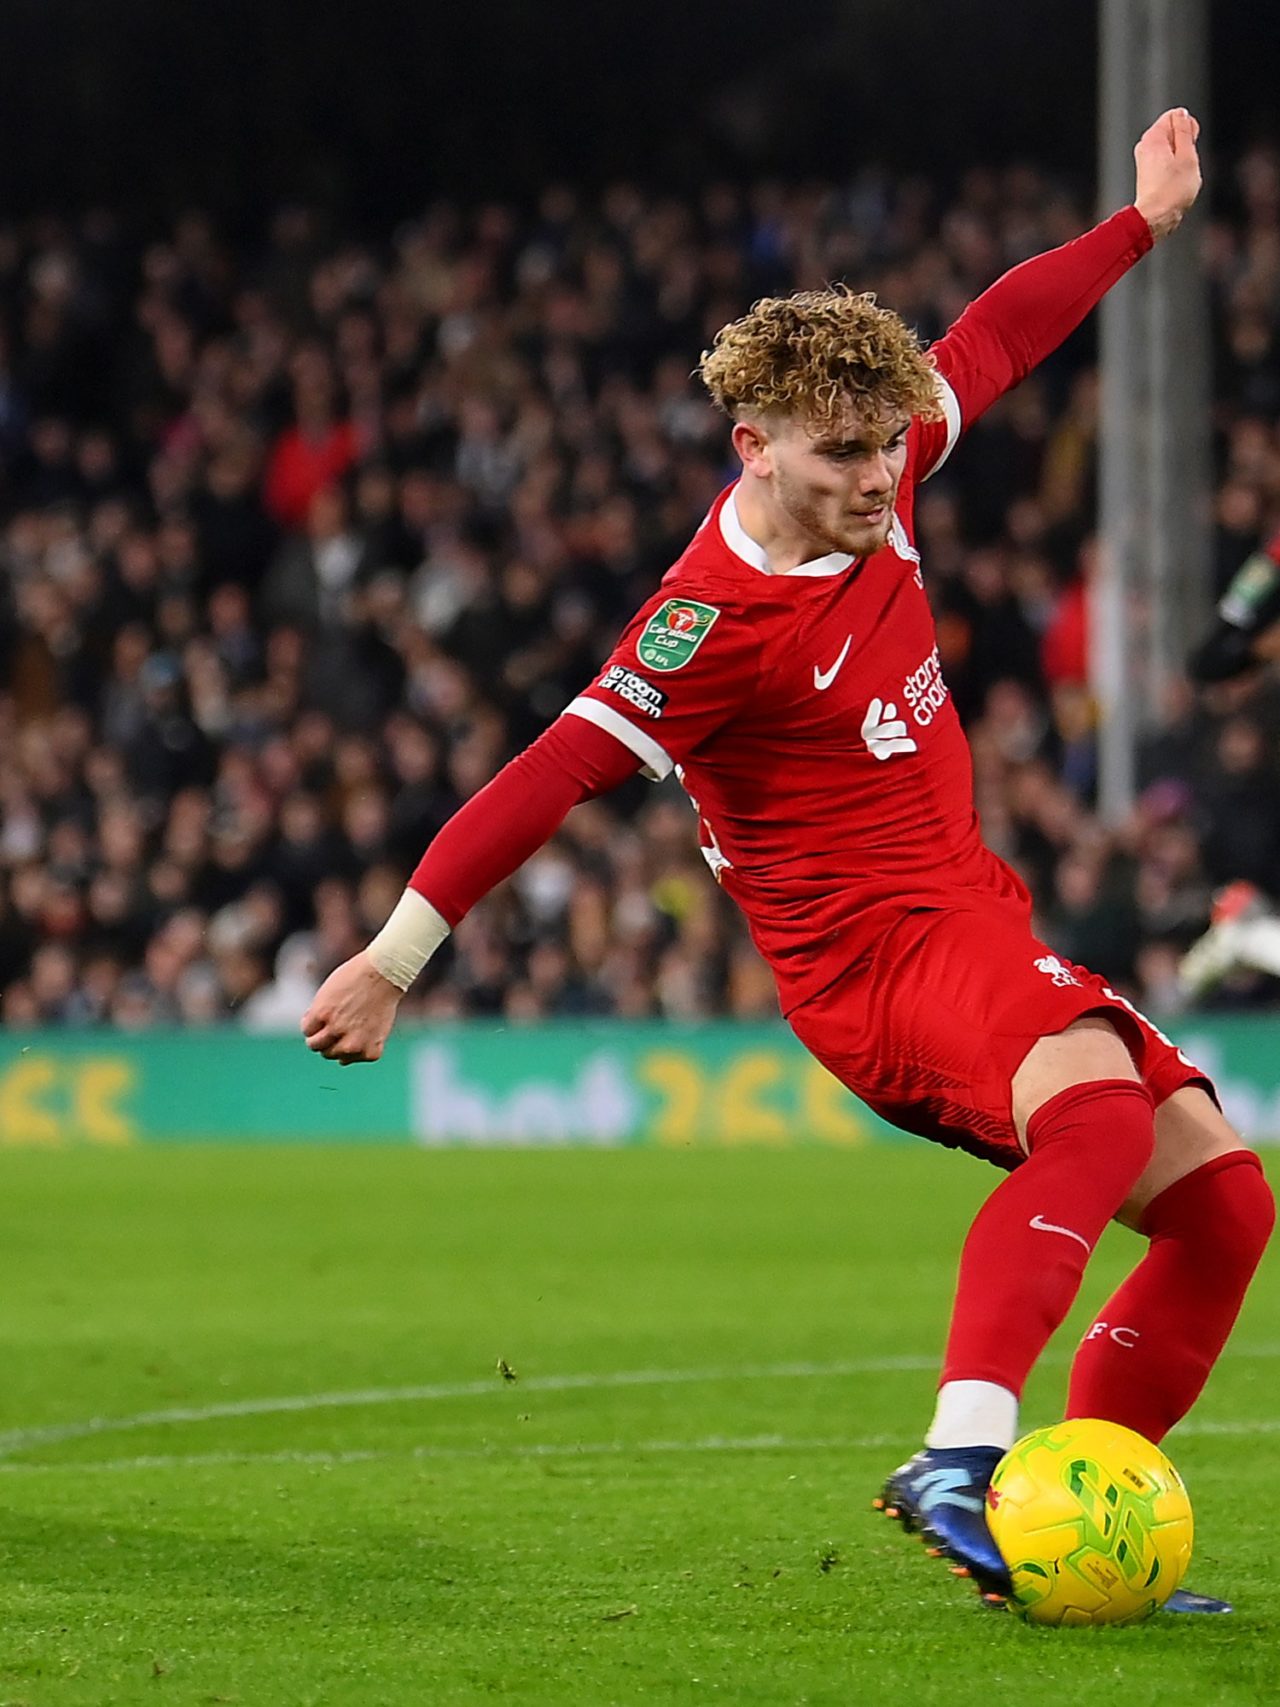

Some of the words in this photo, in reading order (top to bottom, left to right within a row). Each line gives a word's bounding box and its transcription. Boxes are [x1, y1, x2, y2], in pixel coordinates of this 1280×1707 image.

[648, 624, 698, 642] Carabao
[654, 635, 679, 648] Cup
[613, 683, 662, 719] racism
[621, 671, 663, 705] room
